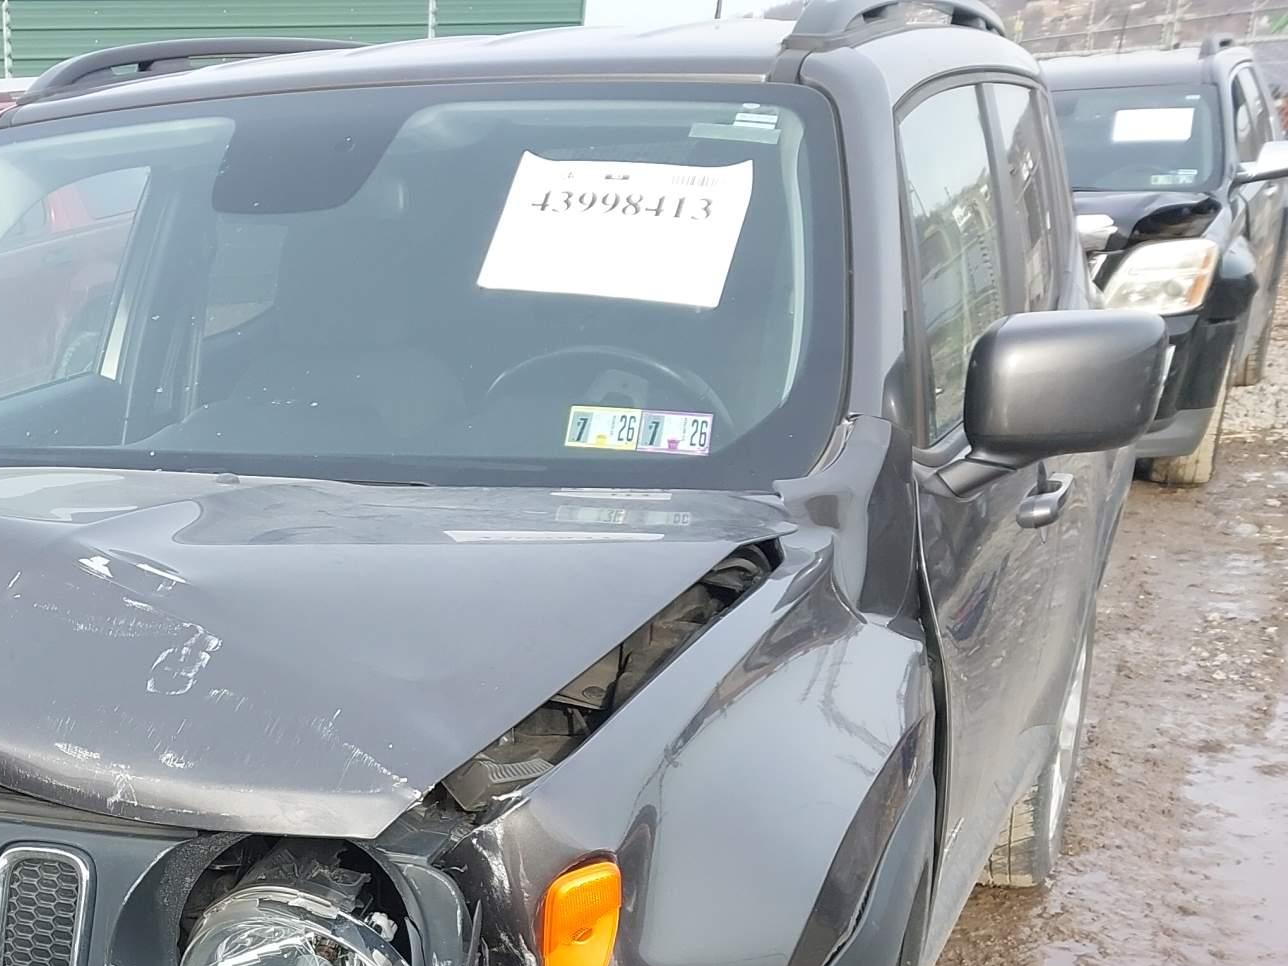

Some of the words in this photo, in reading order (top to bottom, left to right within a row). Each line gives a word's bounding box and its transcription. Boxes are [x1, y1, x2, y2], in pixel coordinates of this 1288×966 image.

[531, 190, 713, 221] 43998413
[576, 417, 589, 442] 7
[617, 414, 637, 443] 26
[648, 420, 660, 446] 7
[689, 418, 708, 448] 26
